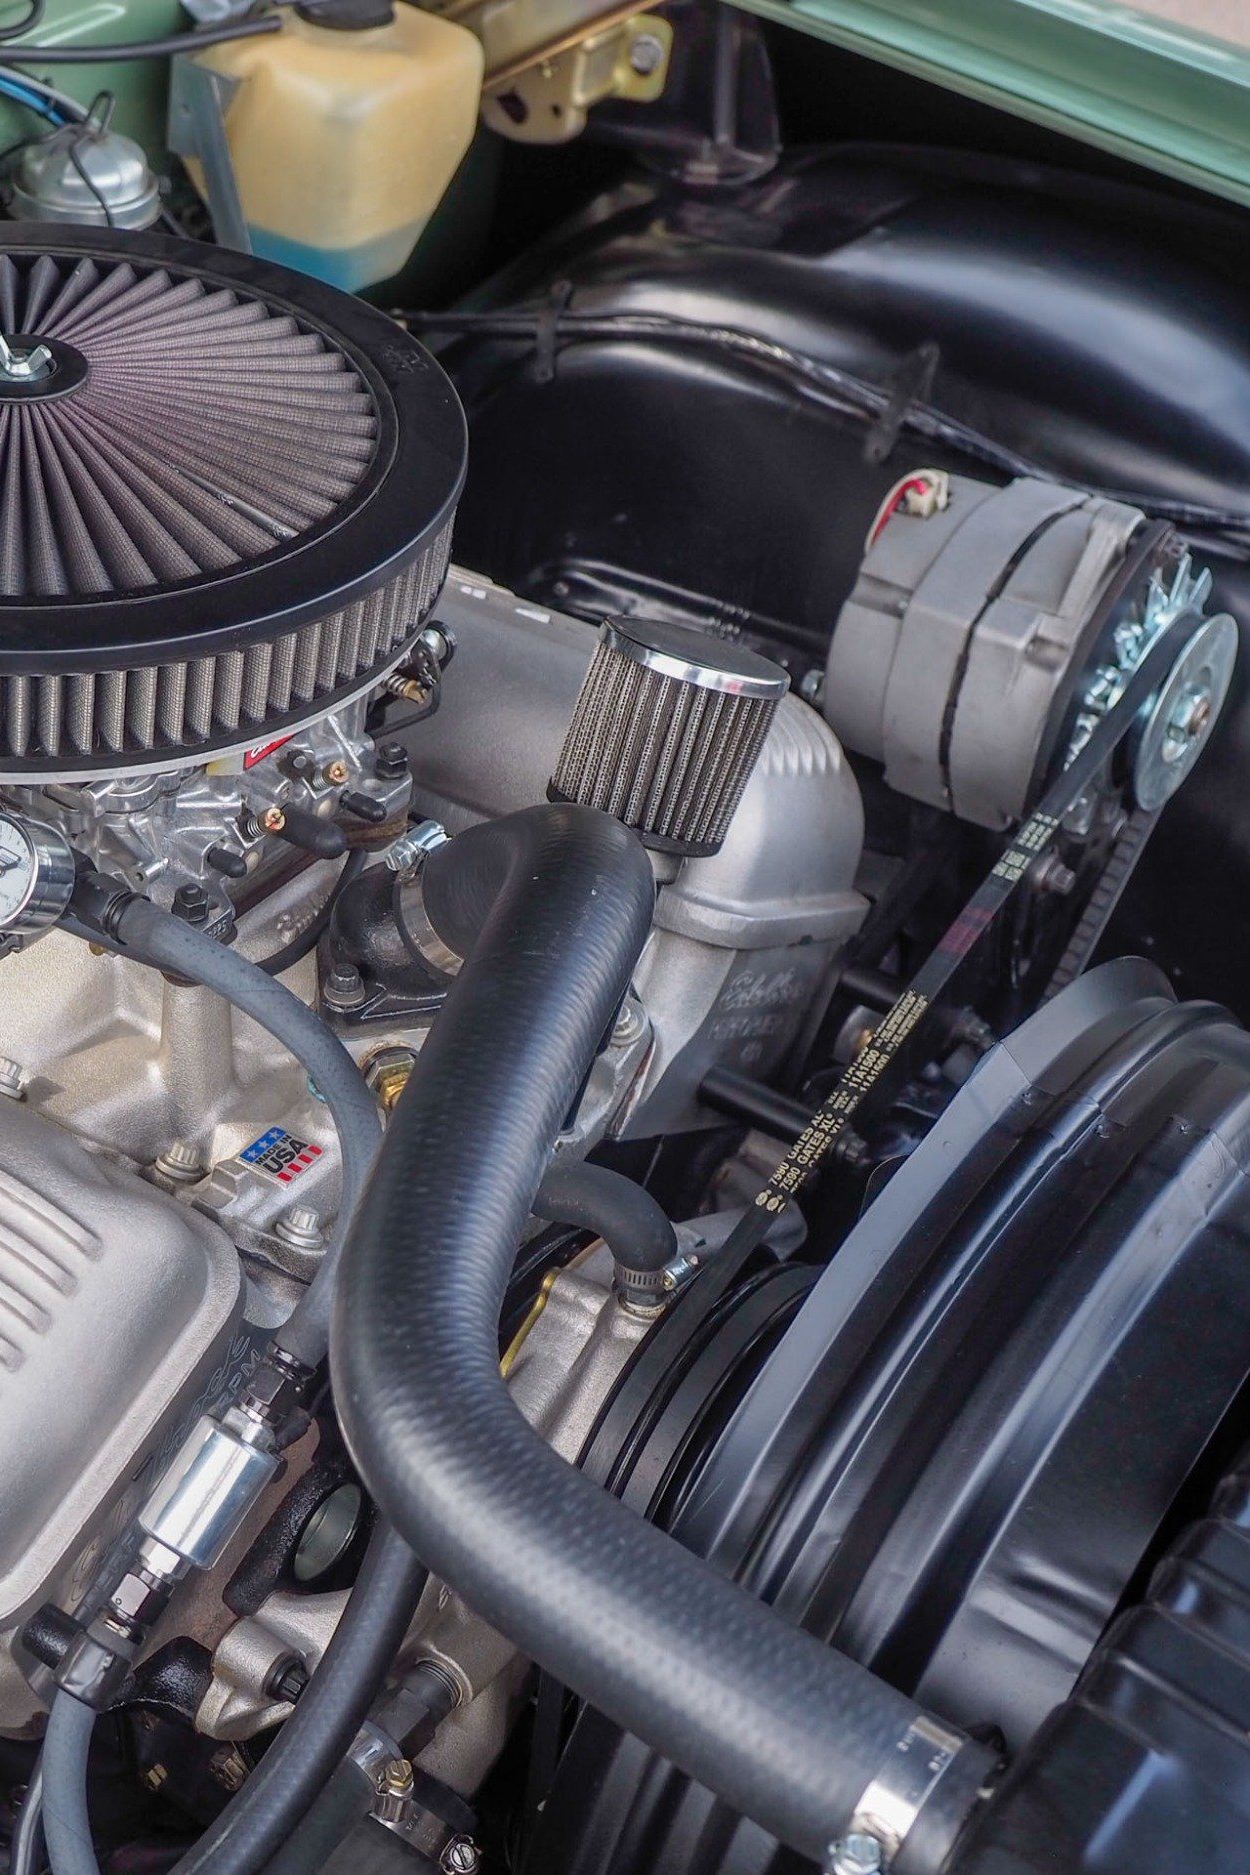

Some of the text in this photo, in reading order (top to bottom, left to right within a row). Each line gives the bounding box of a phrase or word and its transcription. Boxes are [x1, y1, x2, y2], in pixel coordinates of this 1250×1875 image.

[255, 1134, 293, 1166] MADE IN
[262, 1138, 309, 1174] USA
[778, 1166, 801, 1191] 7590
[796, 1131, 825, 1165] GATES
